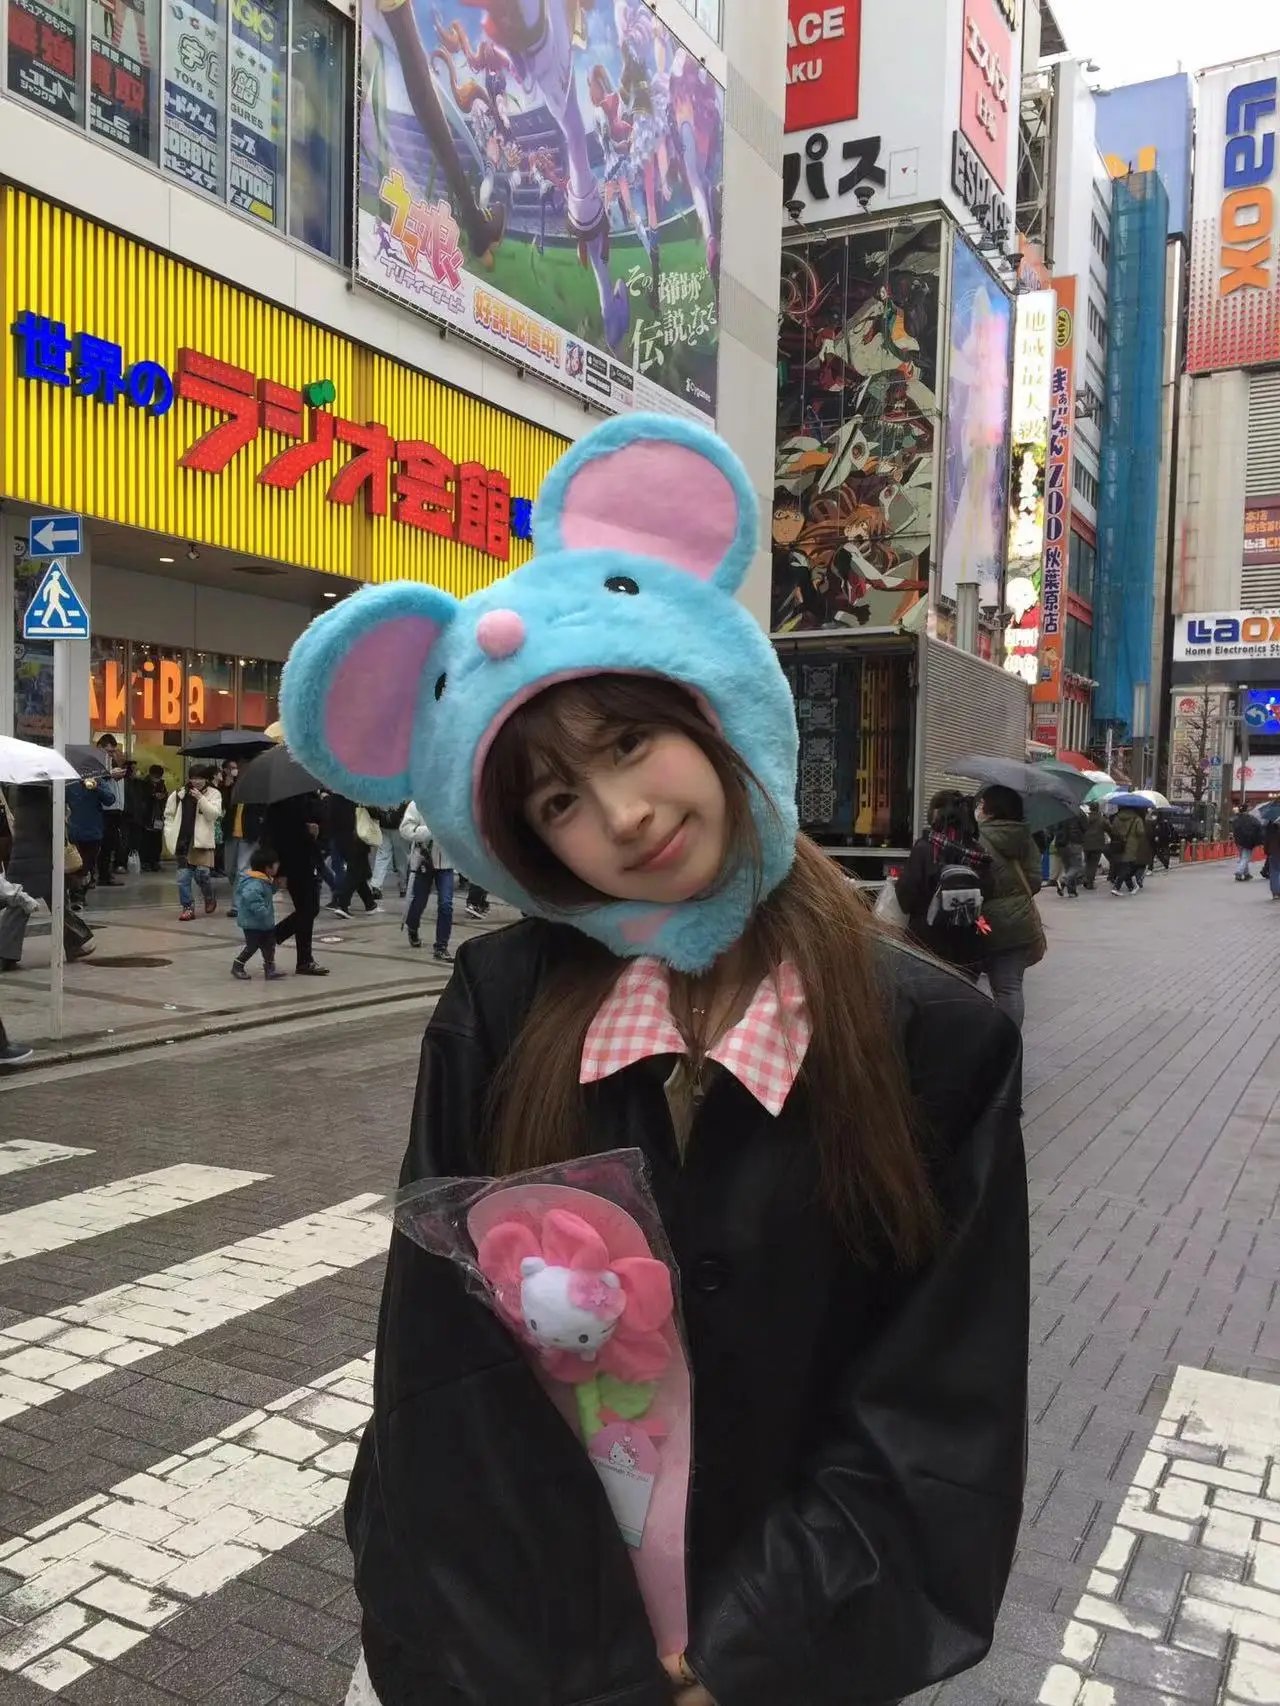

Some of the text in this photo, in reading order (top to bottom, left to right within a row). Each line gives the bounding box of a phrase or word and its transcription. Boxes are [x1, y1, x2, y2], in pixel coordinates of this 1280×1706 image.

[174, 67, 203, 93] TOYS
[1185, 647, 1212, 656] Home
[1215, 644, 1267, 656] Electronics
